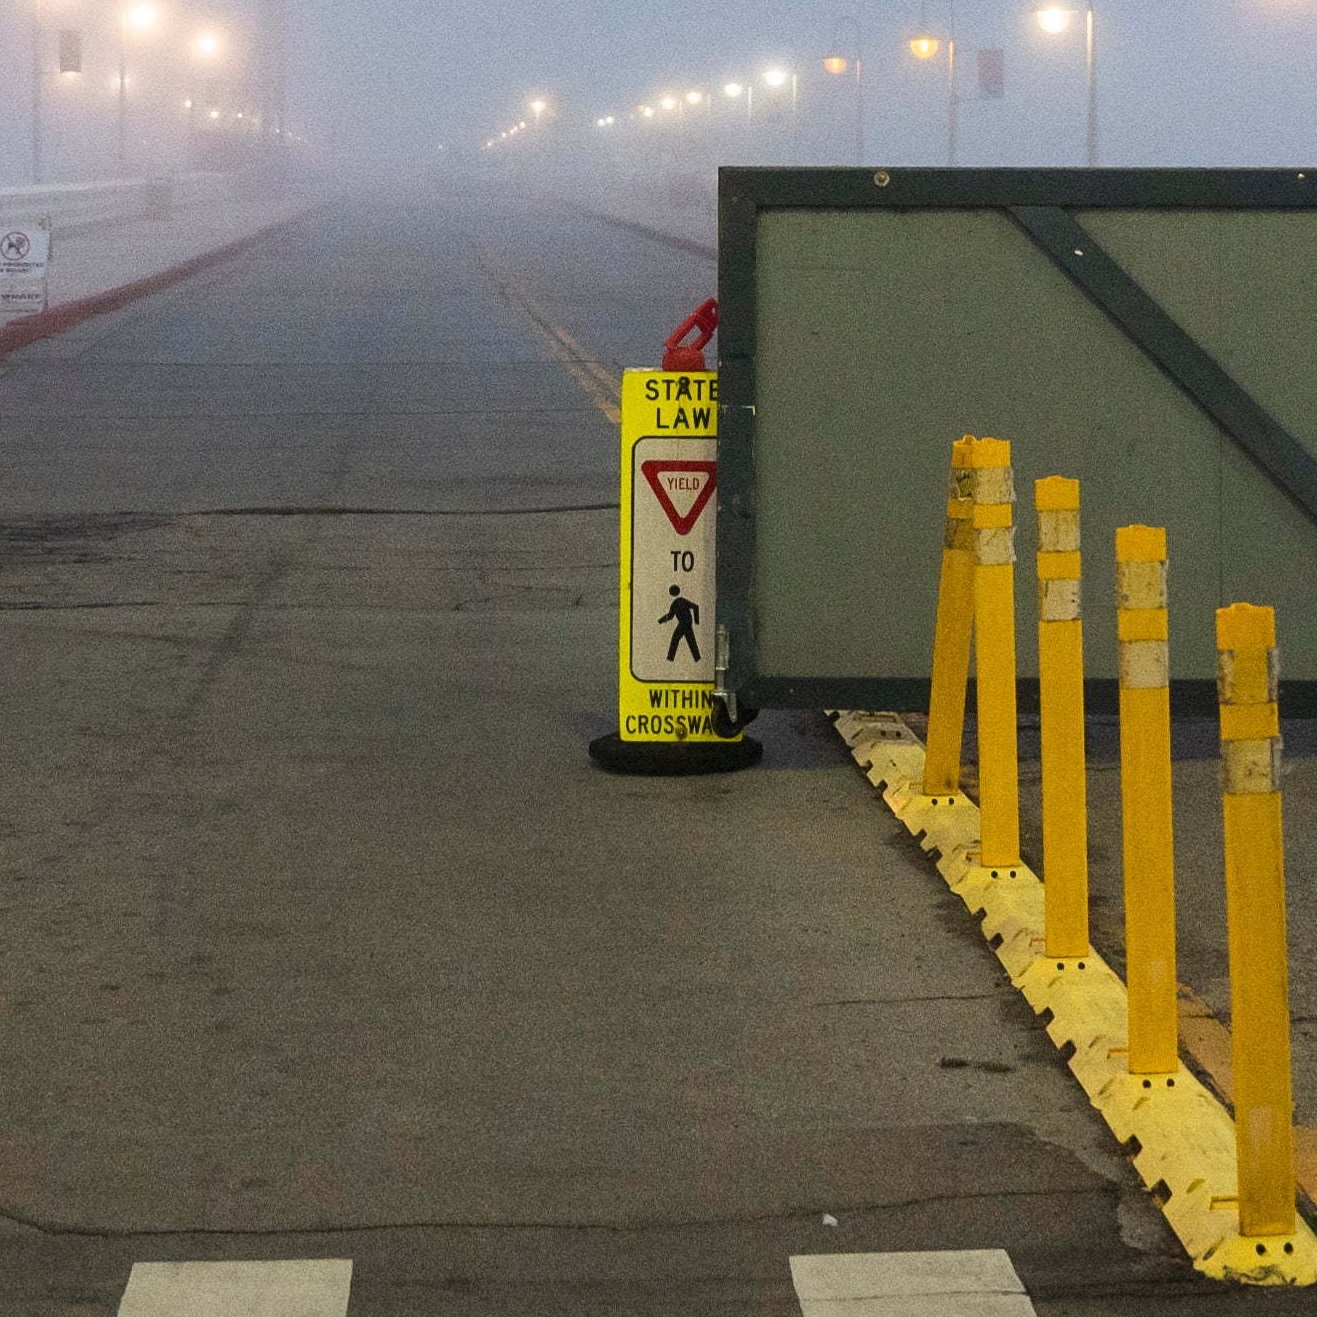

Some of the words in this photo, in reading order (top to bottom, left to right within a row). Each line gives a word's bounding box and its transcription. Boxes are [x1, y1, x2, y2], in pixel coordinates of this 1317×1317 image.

[645, 378, 718, 401] STATE
[656, 407, 711, 429] LAW
[667, 478, 700, 490] YIELD
[670, 550, 695, 572] TO
[649, 689, 713, 709] WITHIN
[625, 715, 712, 735] CROSSWA
